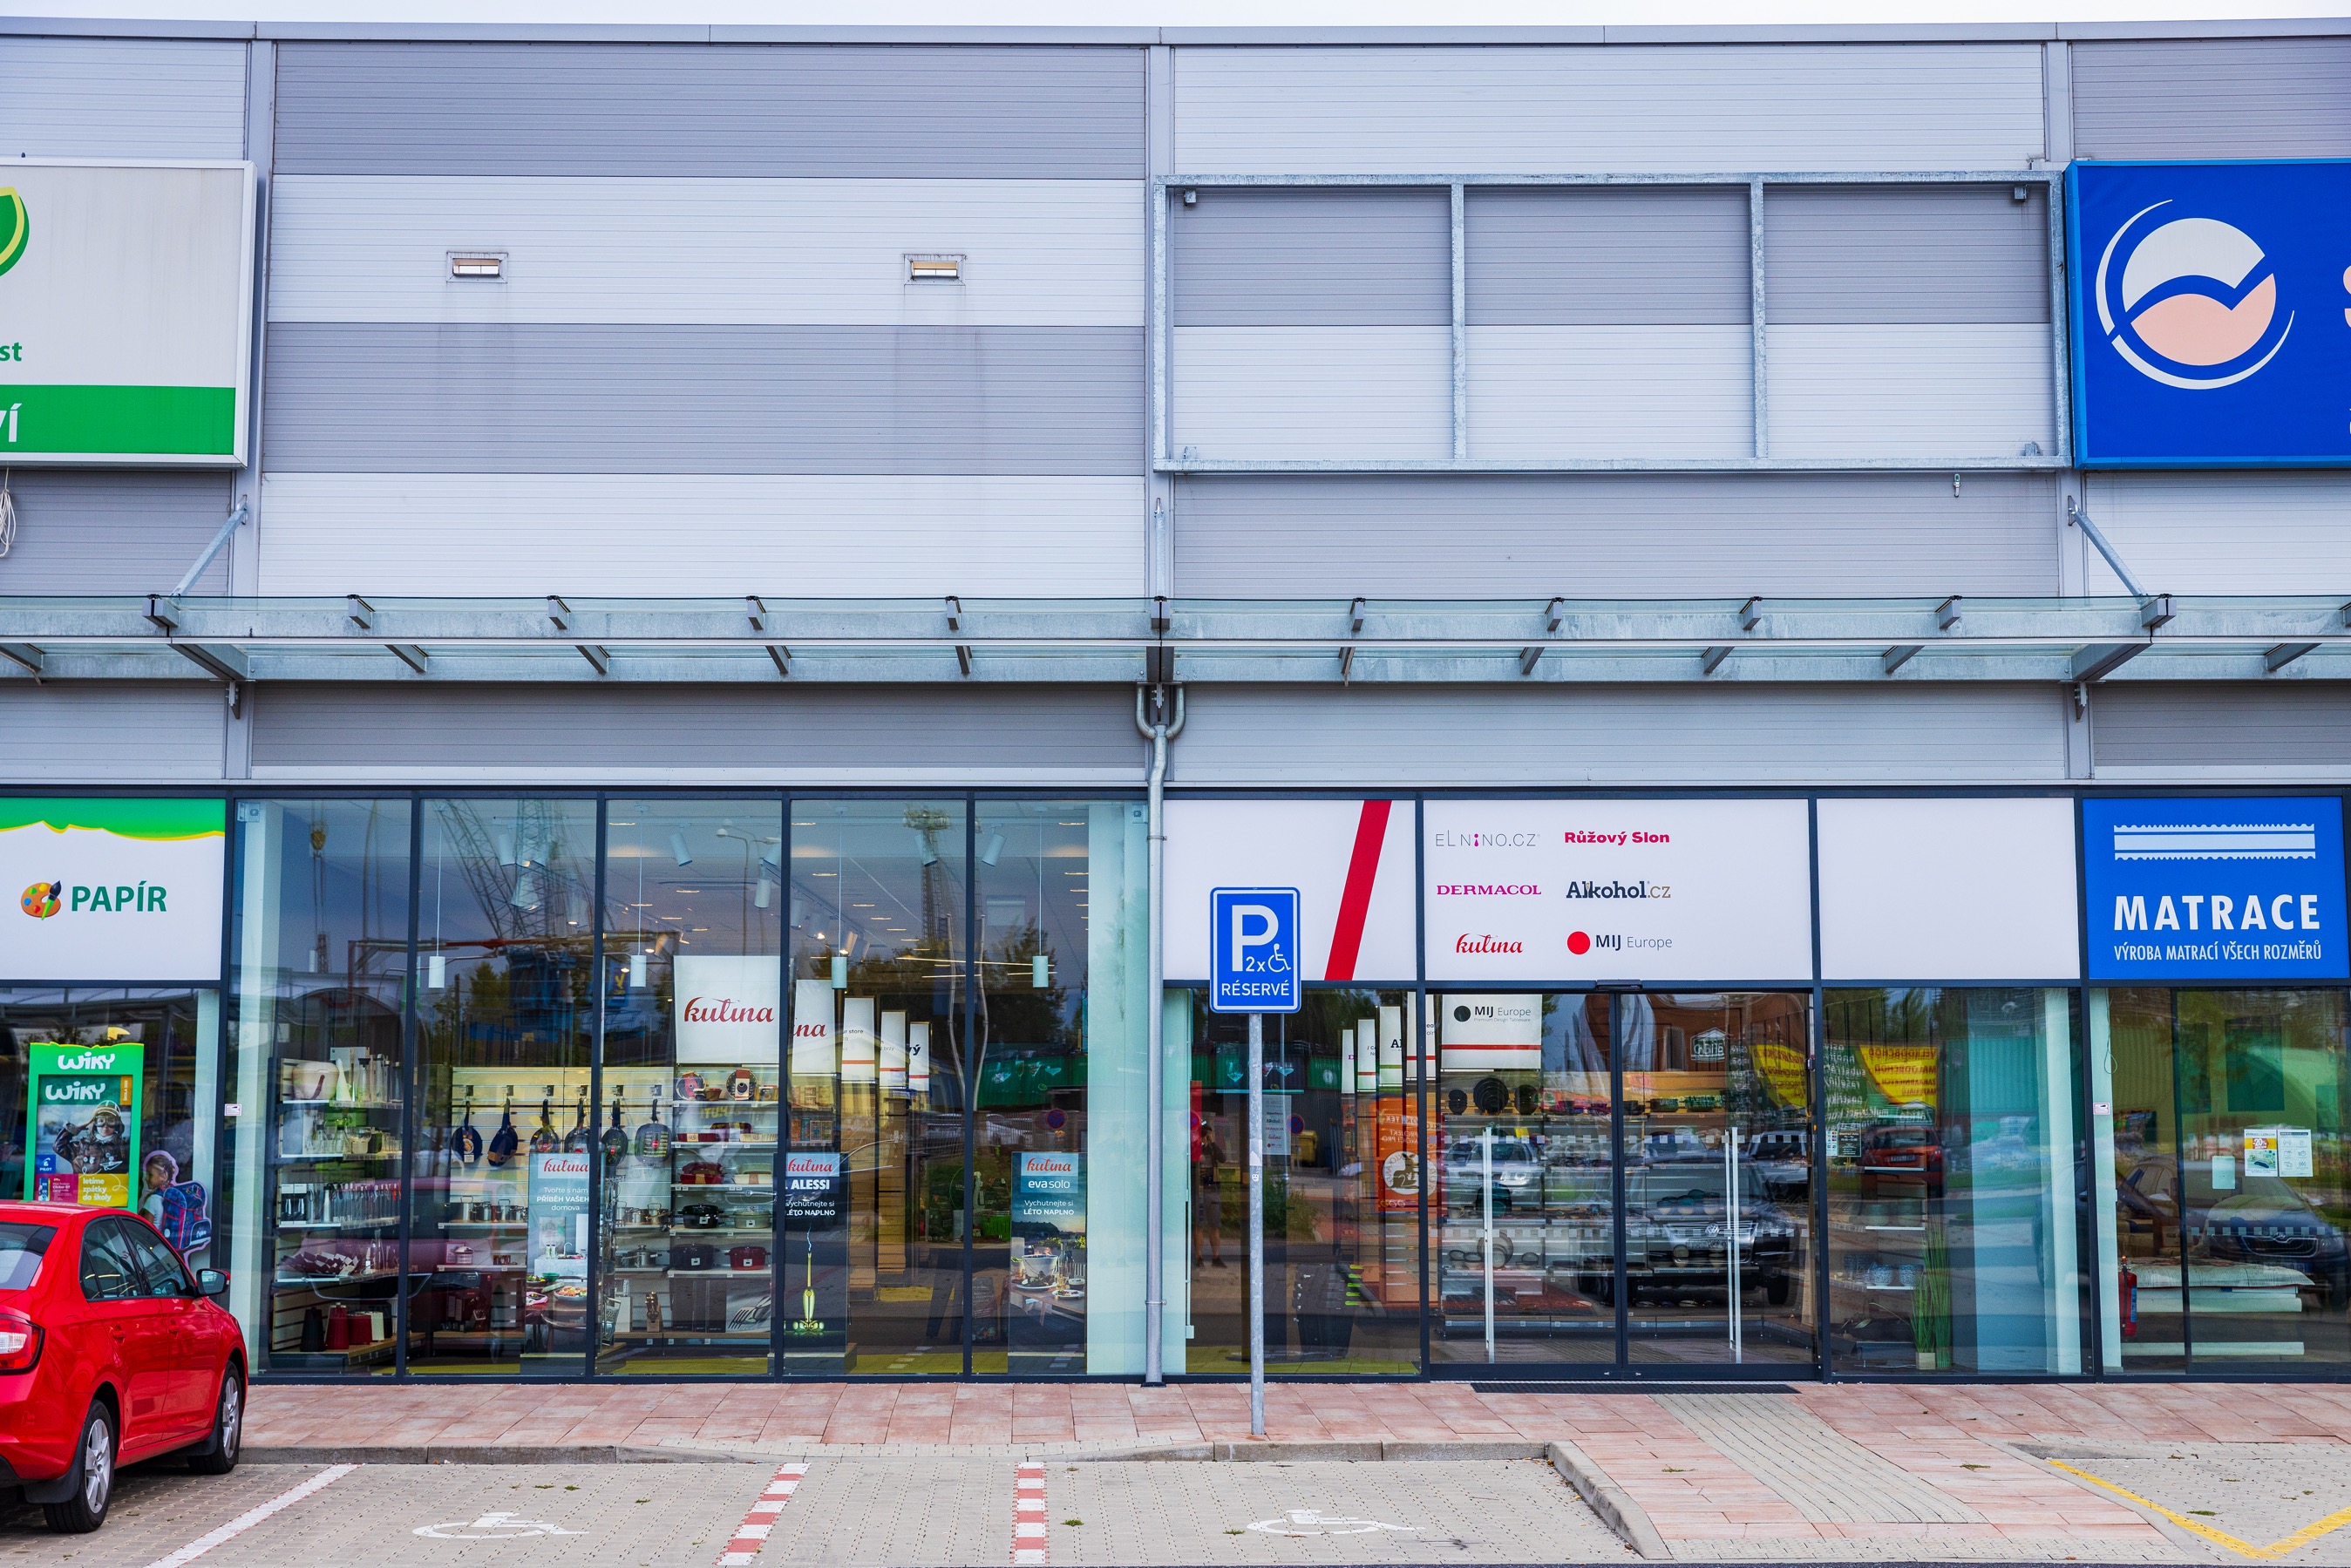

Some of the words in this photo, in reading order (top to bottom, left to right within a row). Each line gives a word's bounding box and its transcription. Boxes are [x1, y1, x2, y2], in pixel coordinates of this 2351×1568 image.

[1564, 830, 1627, 846] Růžový
[1632, 831, 1670, 844] Slon
[71, 880, 167, 913] PAPÍR
[1437, 885, 1542, 895] DERMACOL
[2114, 893, 2320, 931] MATRACE
[1232, 905, 1279, 972] P
[1456, 933, 1524, 954] kulina
[1595, 934, 1621, 952] MIJ
[1627, 936, 1673, 951] Europe
[2114, 941, 2162, 960] VÝROBA
[2166, 940, 2219, 960] MATRACÍ
[2222, 940, 2259, 960] VŠECH
[2264, 939, 2321, 960] ROZMĚRŮ
[1245, 956, 1266, 972] 2x
[1221, 979, 1290, 996] RÉSERVÉ
[683, 996, 775, 1023] kulina
[1474, 1006, 1494, 1018] MIJ
[1498, 1007, 1532, 1018] Europe
[543, 1157, 589, 1172] kulina
[787, 1157, 833, 1172] kulina
[1026, 1157, 1072, 1172] kulina
[791, 1179, 830, 1190] ALESSI
[565, 1194, 589, 1203] VAŠEH
[1023, 1199, 1067, 1208] Vychutnejte
